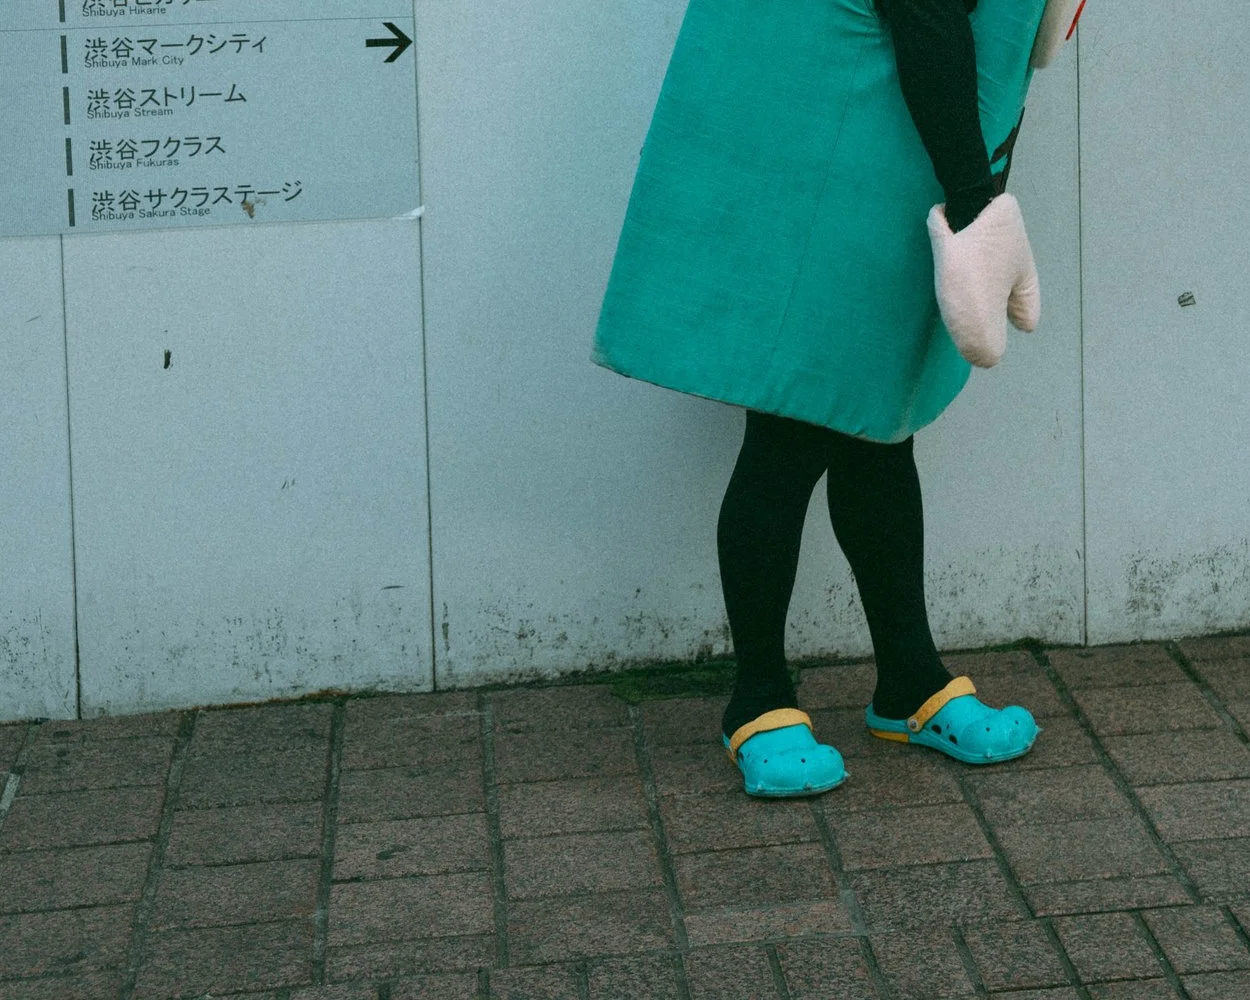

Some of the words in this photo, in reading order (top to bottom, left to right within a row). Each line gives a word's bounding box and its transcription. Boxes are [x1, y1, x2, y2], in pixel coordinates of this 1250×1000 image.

[83, 6, 125, 17] Shibuya
[129, 5, 166, 15] Hikarie
[85, 34, 268, 60] 渋谷マークシティ
[85, 57, 128, 69] Shibuya
[132, 56, 157, 67] Mark
[162, 55, 184, 67] City
[87, 83, 247, 111] 渋谷ストリーム
[87, 108, 130, 120] Shibuya
[134, 107, 173, 117] Stream
[89, 136, 226, 162] 渋谷フクラス
[89, 159, 132, 171] Shibuya
[136, 158, 179, 168] Fukuras
[92, 180, 303, 212] 渋谷サクラステージ
[92, 210, 134, 221] Shibuya
[138, 208, 175, 218] Sakura
[179, 207, 210, 218] Stage
